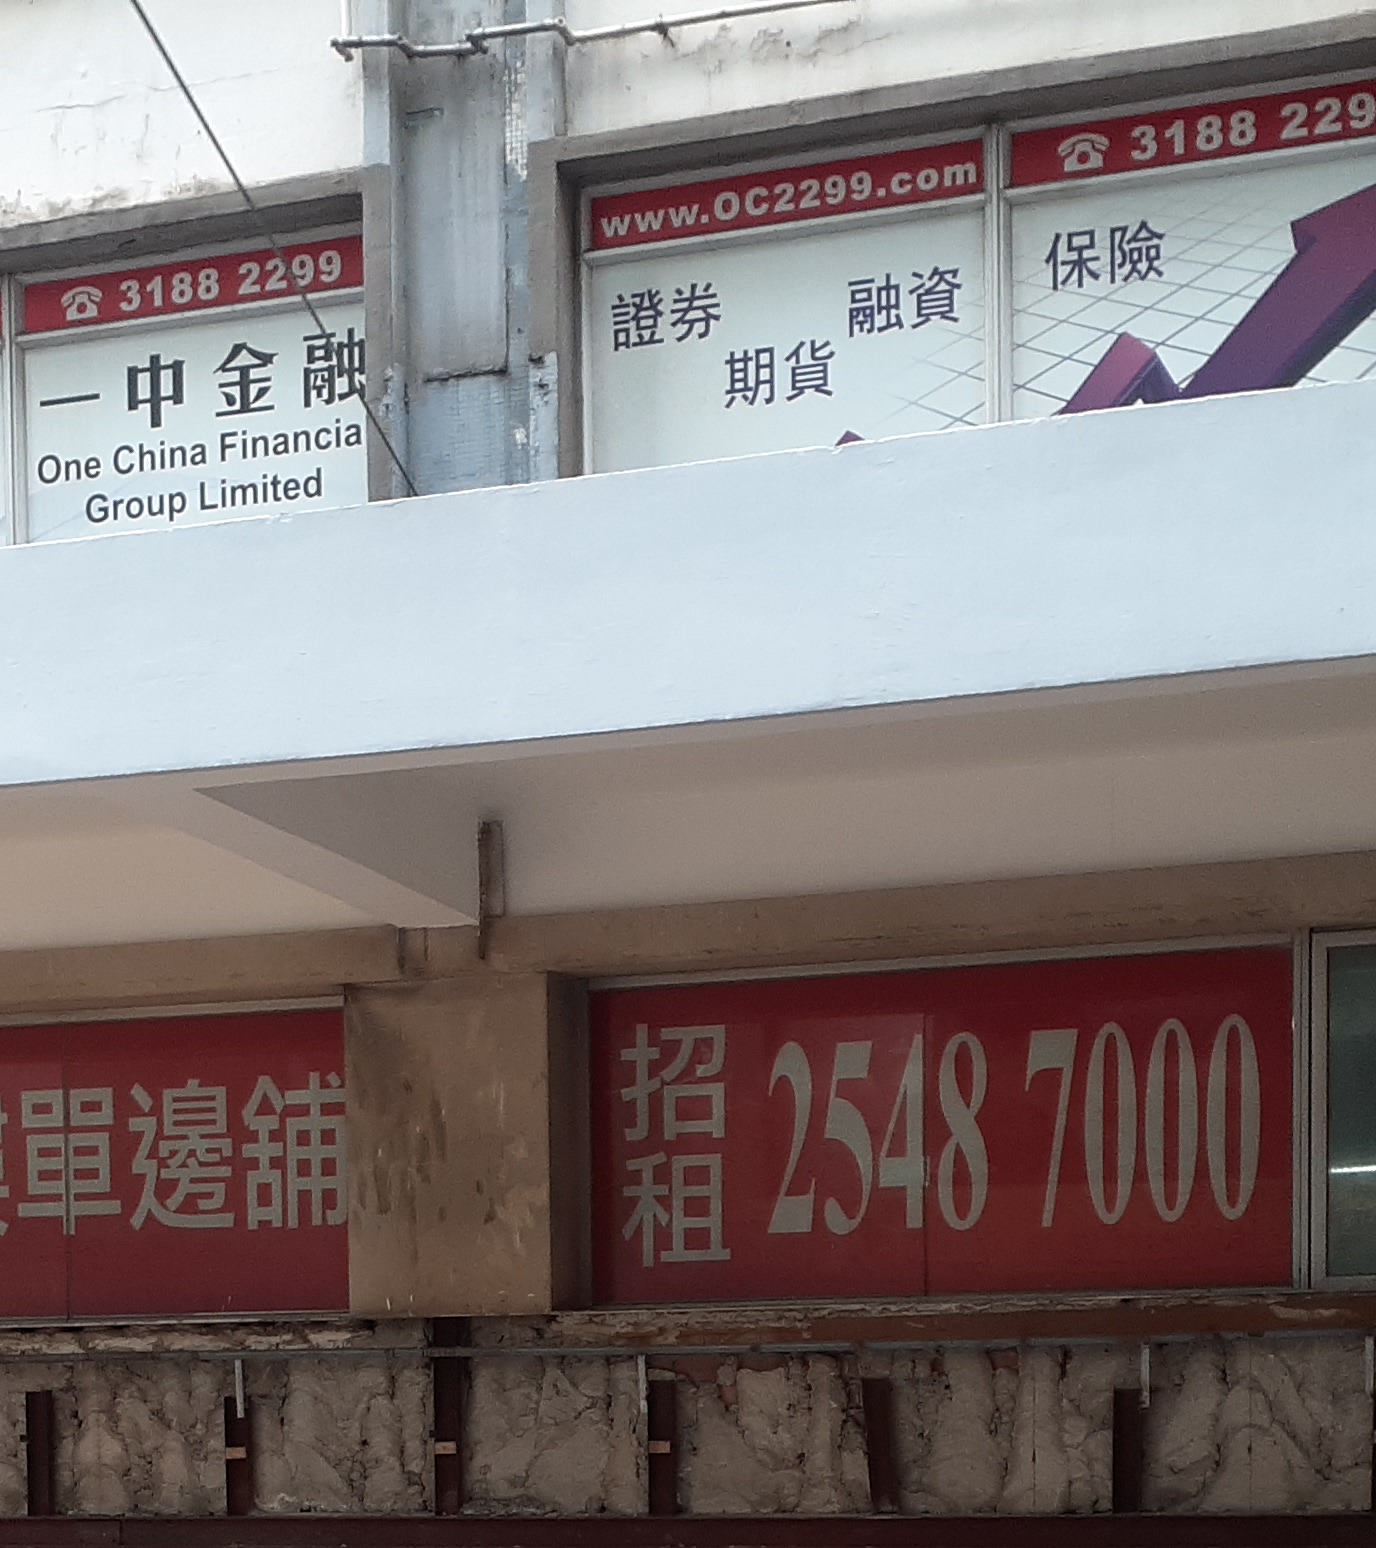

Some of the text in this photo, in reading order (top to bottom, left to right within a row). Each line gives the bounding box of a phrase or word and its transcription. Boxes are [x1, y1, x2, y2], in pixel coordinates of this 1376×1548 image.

[1131, 109, 1257, 162] 3188
[600, 158, 977, 241] www.OC2299.com
[120, 250, 342, 312] 3188 2299
[1046, 220, 1166, 291] 保險
[610, 283, 722, 350] 證券
[847, 266, 962, 338] 融資
[40, 327, 365, 428] 一中金融
[725, 339, 835, 409] 期貨
[38, 449, 101, 485] One
[113, 439, 208, 476] China
[86, 467, 322, 524] Group Limited
[620, 1024, 731, 1267] 招租
[767, 1013, 1262, 1236] 2548 7000
